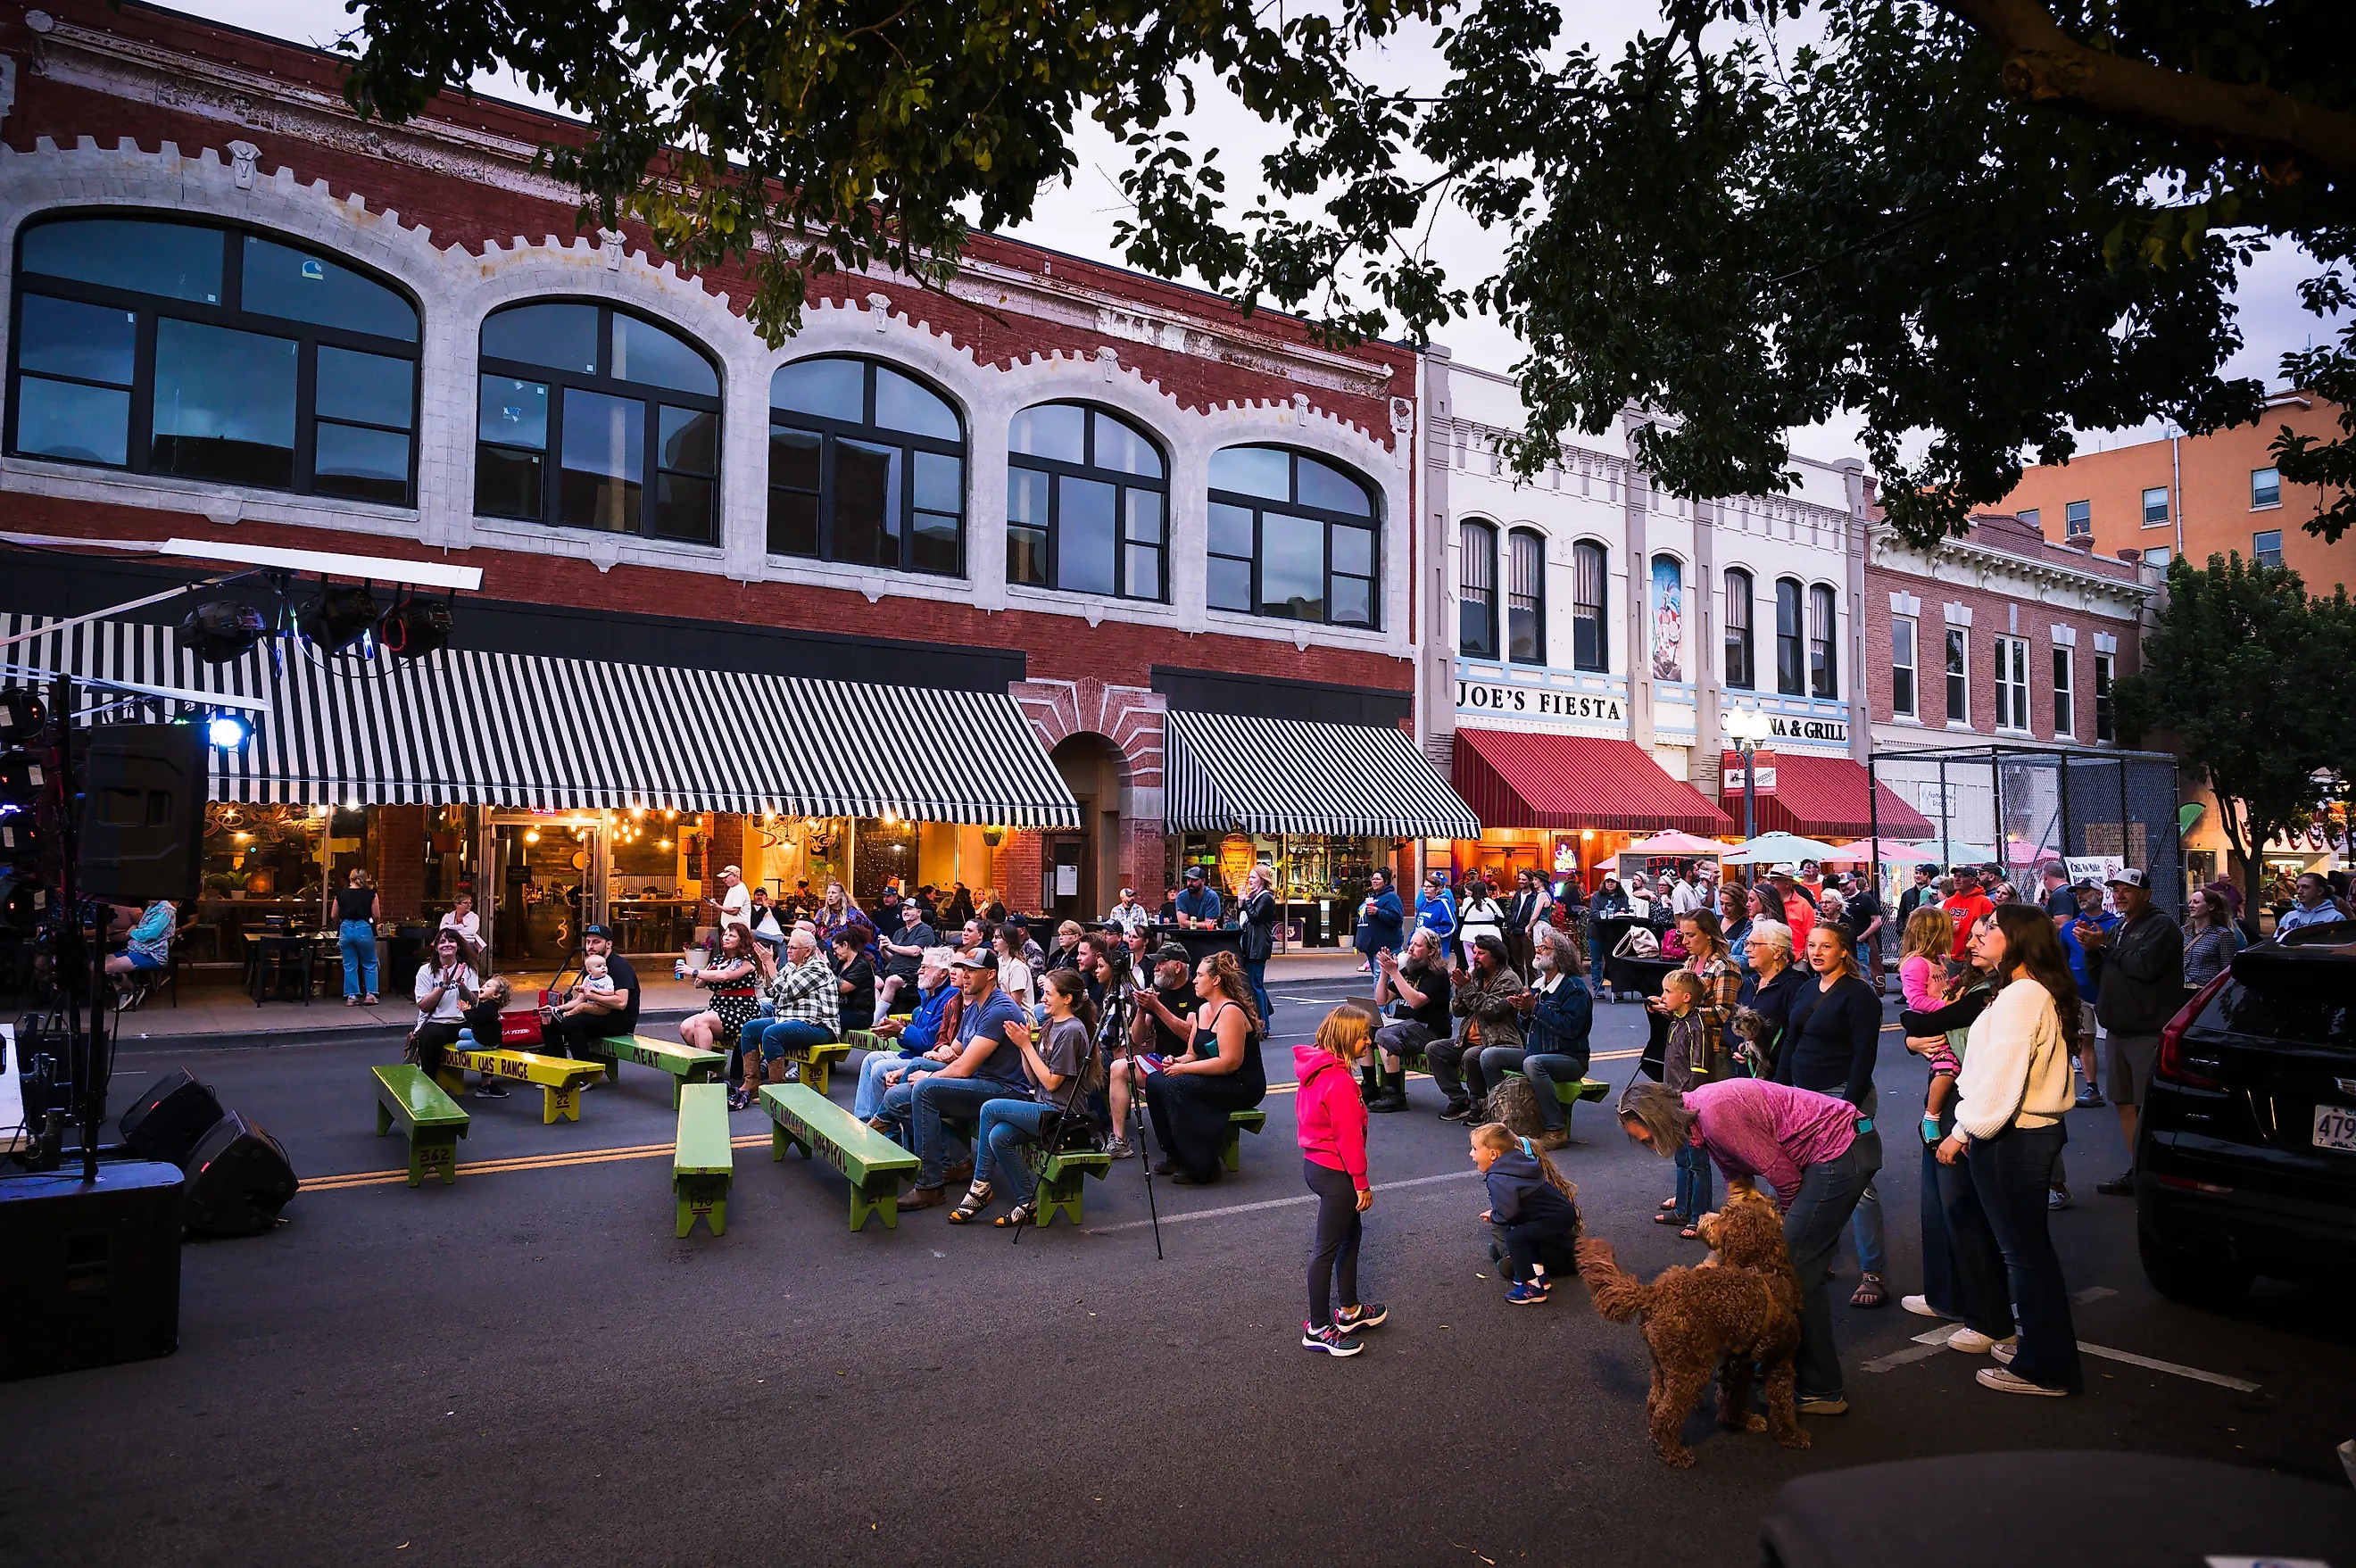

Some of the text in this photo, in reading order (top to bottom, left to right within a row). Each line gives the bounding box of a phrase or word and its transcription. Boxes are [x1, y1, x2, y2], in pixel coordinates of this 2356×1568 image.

[1456, 681, 1621, 720] JOE'S FIESTA
[1790, 720, 1802, 737] &
[1804, 721, 1846, 742] GRILL
[441, 1049, 529, 1080] NDLETON UAS RANGE
[633, 1047, 660, 1067] MEAT
[809, 1068, 823, 1079] 210
[556, 1094, 569, 1106] 22
[419, 1148, 451, 1163] 362
[813, 1130, 848, 1174] HOSPITAL
[690, 1196, 714, 1209] 190
